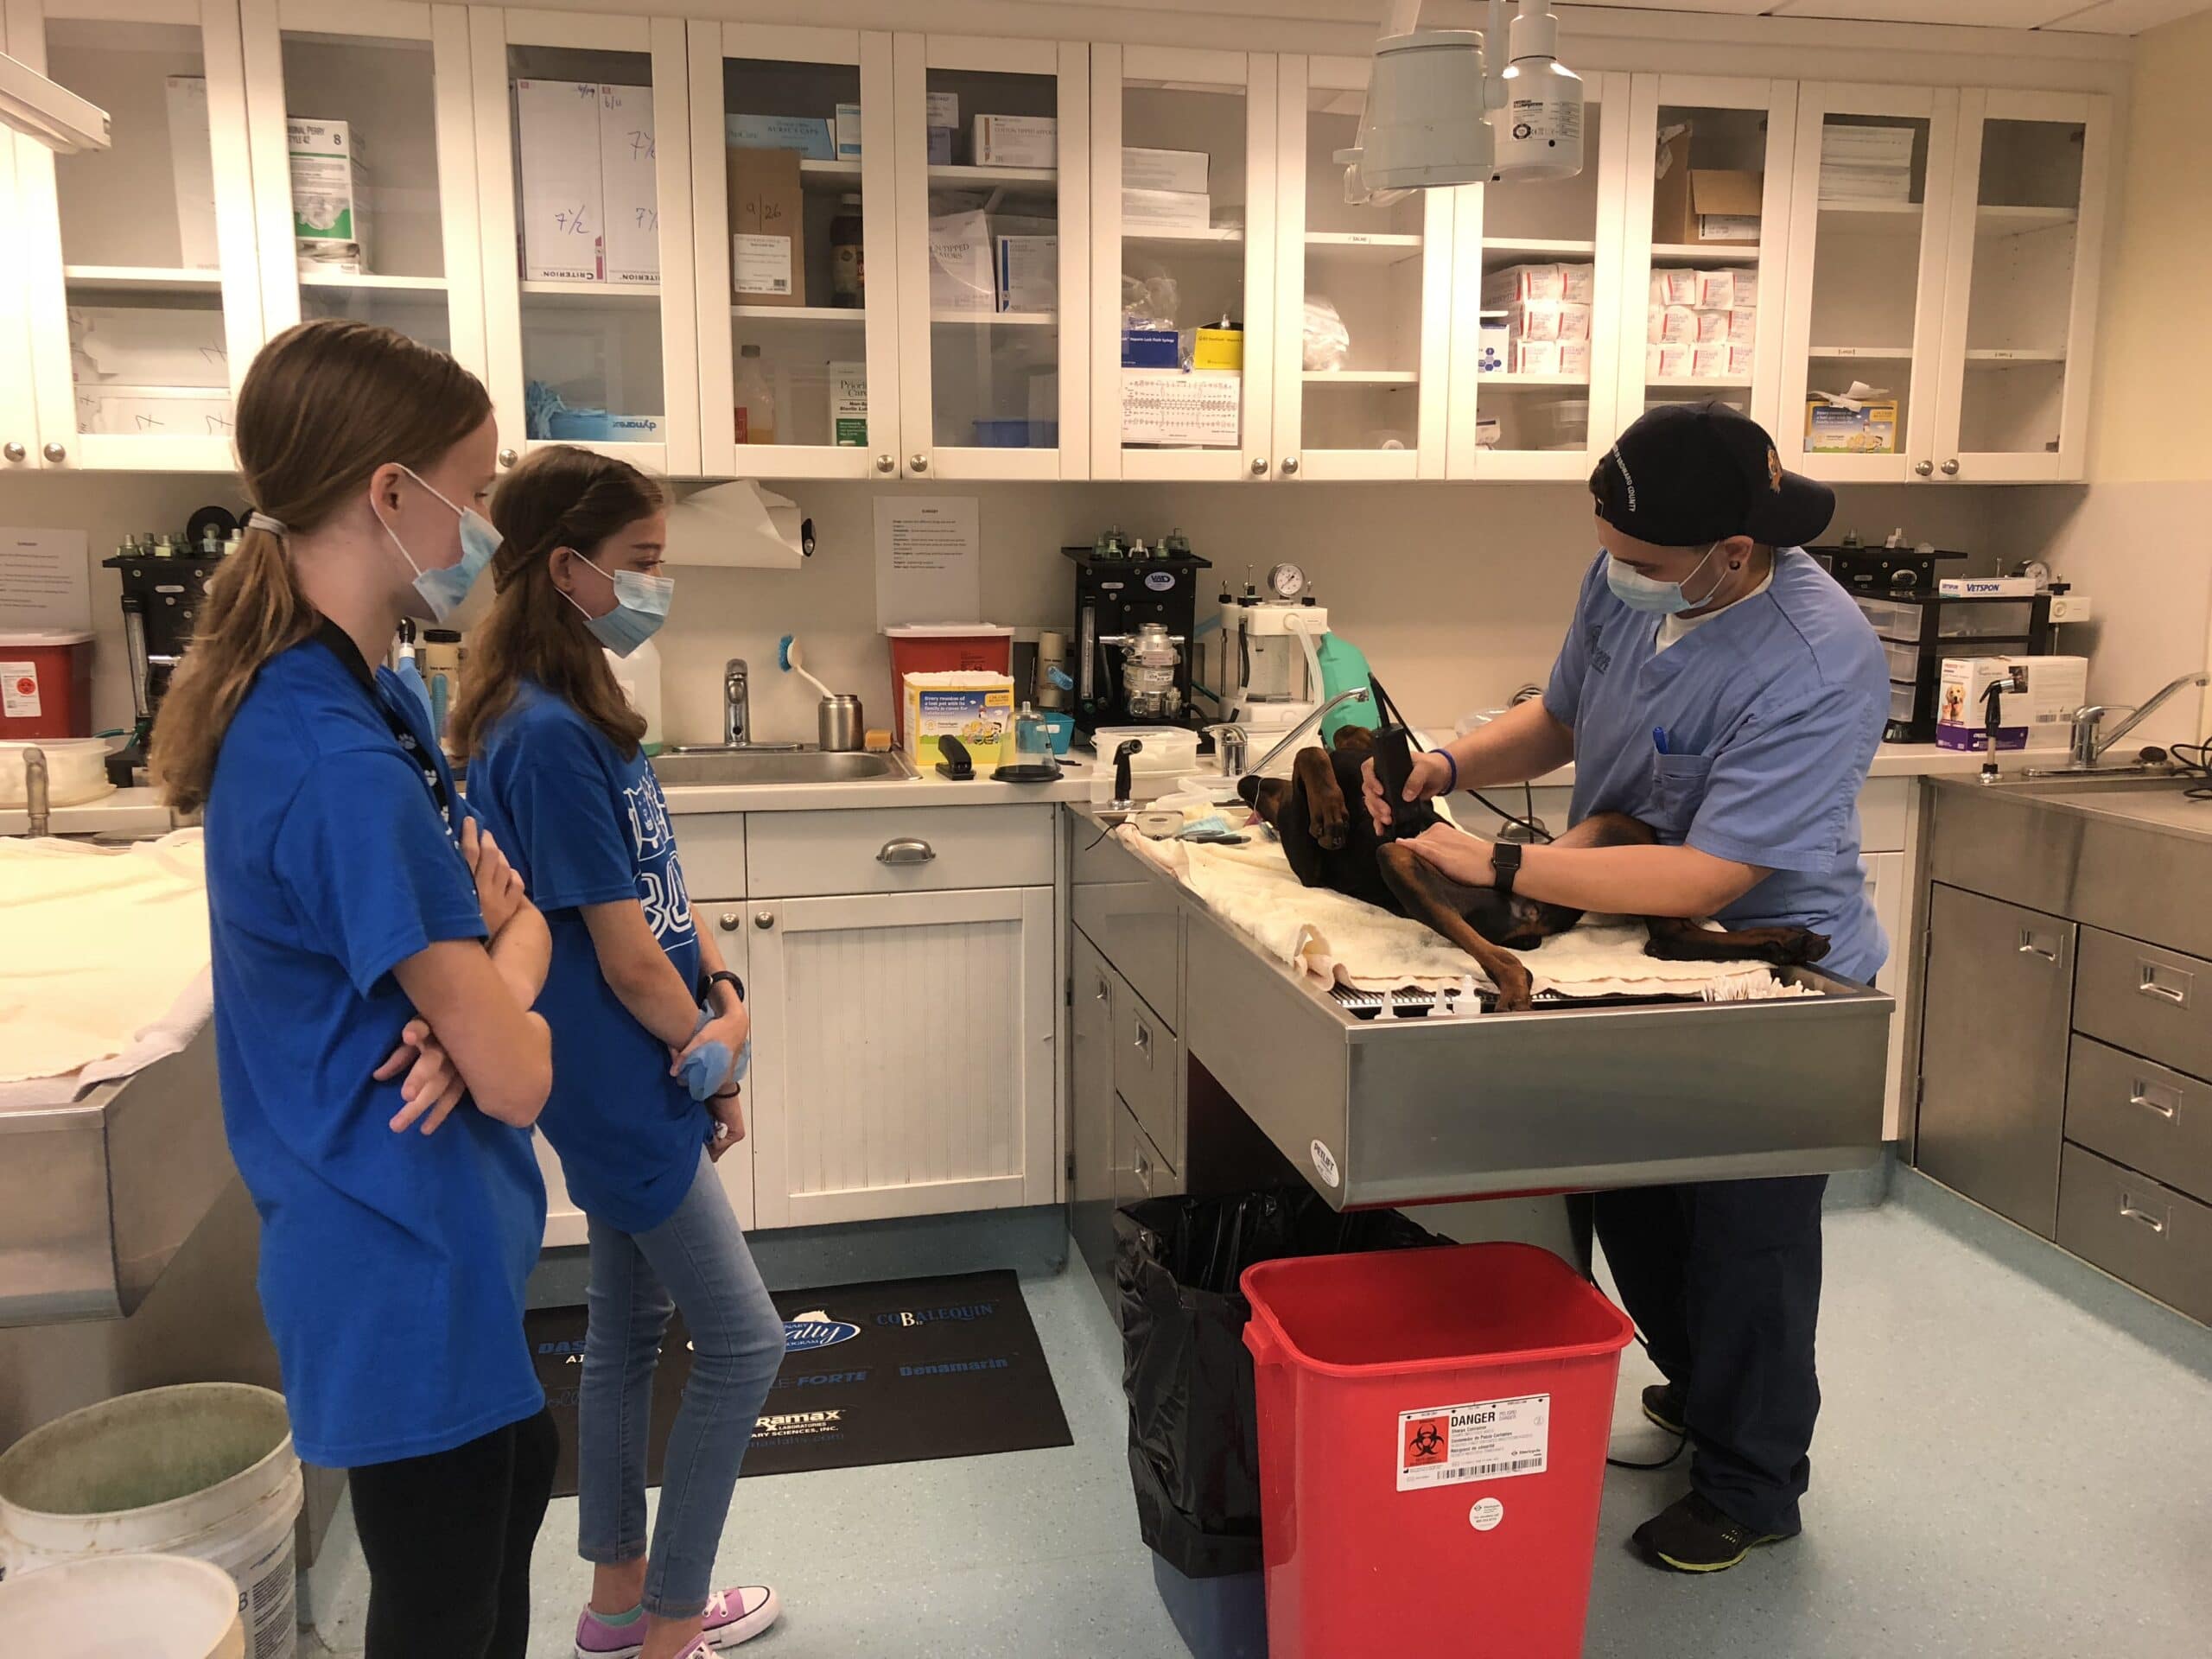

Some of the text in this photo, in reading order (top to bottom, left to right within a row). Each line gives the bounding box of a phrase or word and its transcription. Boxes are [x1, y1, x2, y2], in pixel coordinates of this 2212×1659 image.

[334, 134, 342, 145] 8
[543, 270, 594, 280] CRITERION
[622, 273, 660, 282] ITERION
[613, 420, 657, 431] dynarex
[1627, 486, 1637, 512] COUNTY
[1967, 583, 1999, 593] VETSPON
[785, 1323, 841, 1345] alty
[537, 1340, 586, 1354] DAS
[899, 1357, 1009, 1376] Denamarin
[797, 1370, 868, 1387] FORTE
[754, 1409, 843, 1431] Ramax
[1451, 1411, 1496, 1427] DANGER
[772, 1427, 818, 1436] SCIENCES,
